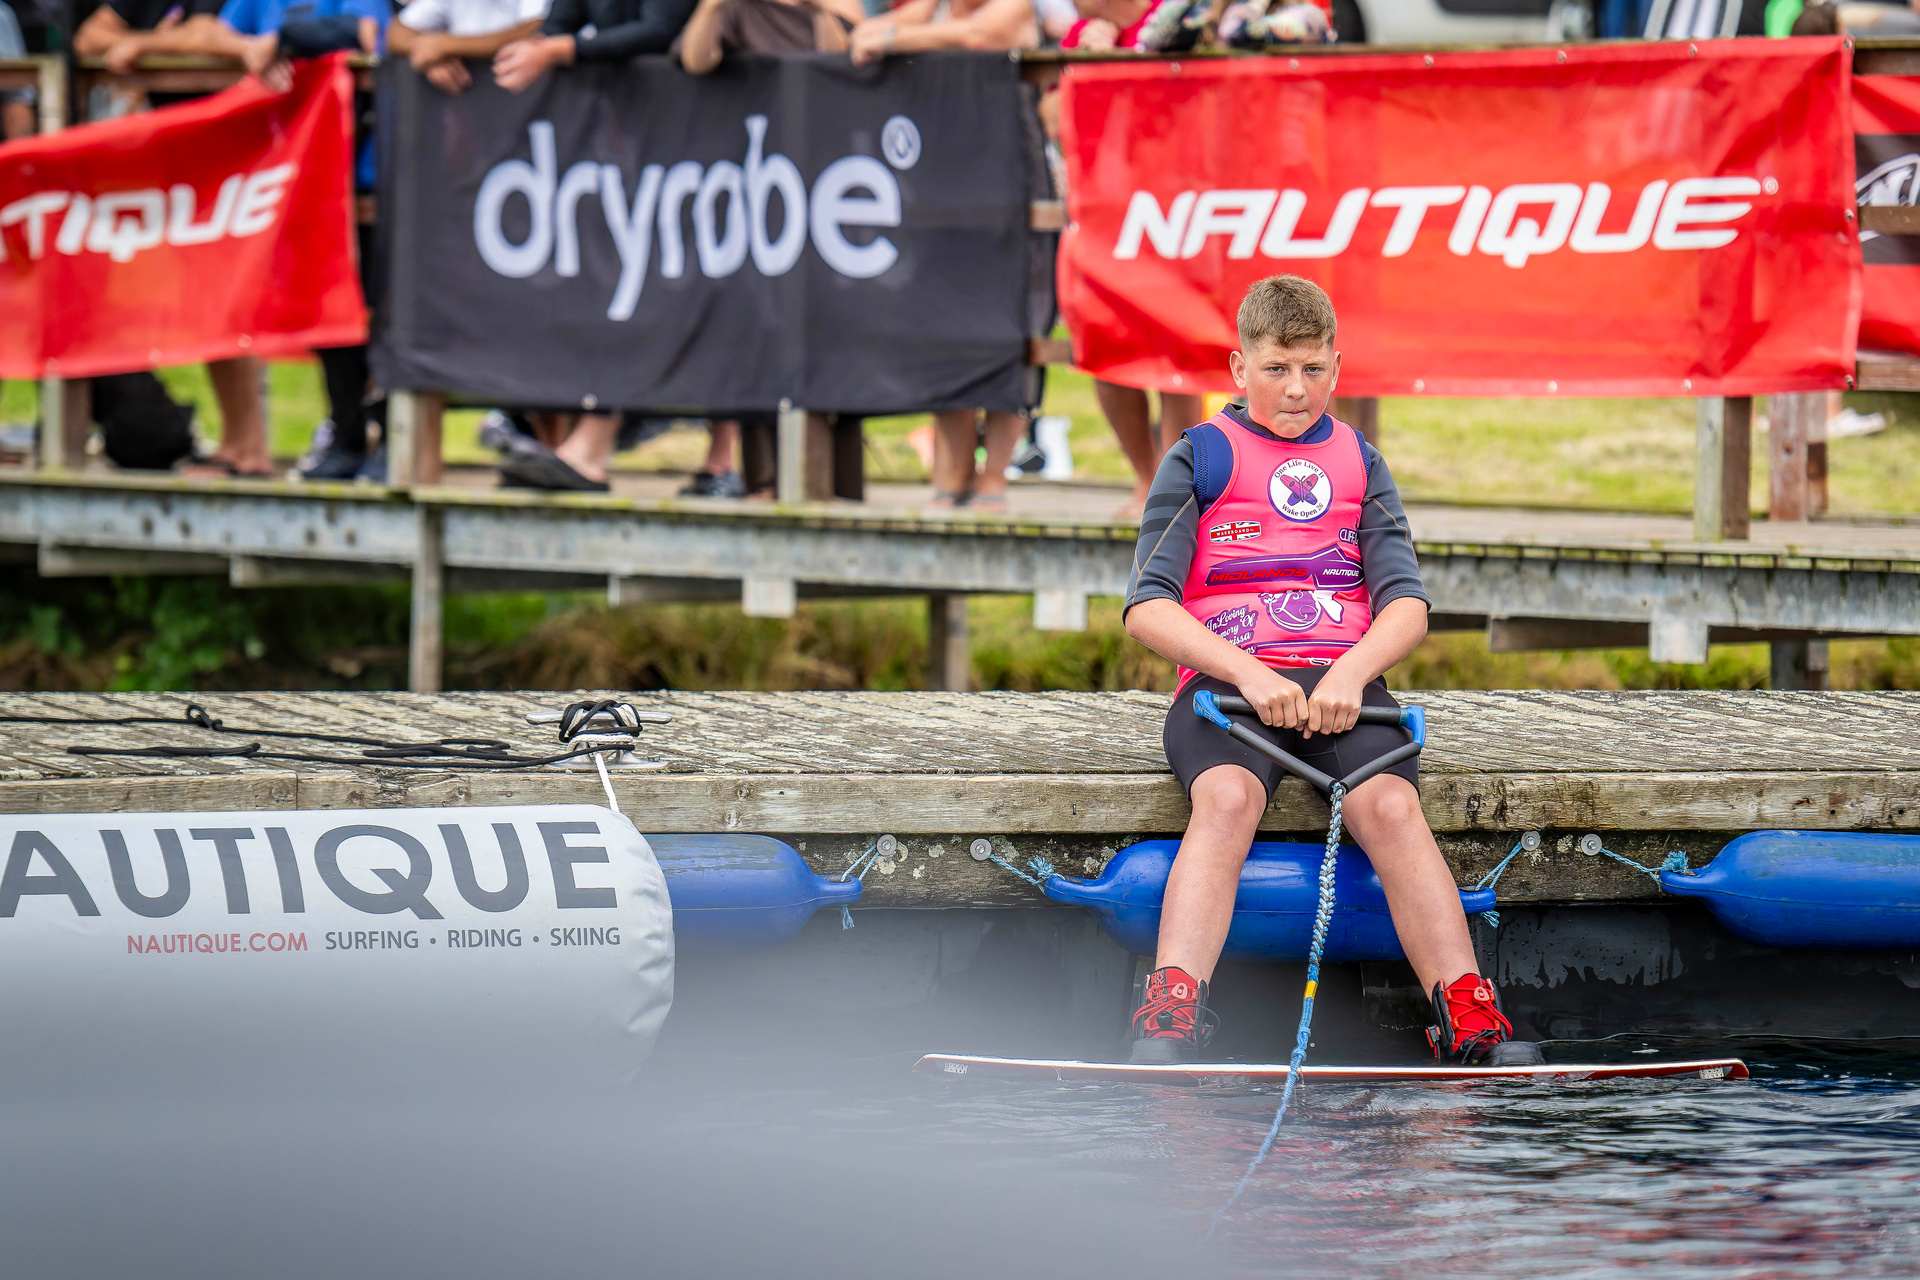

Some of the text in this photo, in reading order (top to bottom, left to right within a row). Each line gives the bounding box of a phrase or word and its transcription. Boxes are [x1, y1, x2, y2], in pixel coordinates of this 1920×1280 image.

[0, 162, 299, 263] TIQUE
[473, 114, 902, 322] dryrobe
[1112, 176, 1762, 268] NAUTIQUE
[1274, 465, 1287, 478] One
[1287, 460, 1302, 468] Life
[1304, 461, 1319, 473] Live
[1282, 504, 1299, 516] Wake
[1300, 508, 1318, 518] Open
[1209, 568, 1309, 582] MIDLANDS
[1322, 568, 1360, 577] NAUTIQUE
[1206, 607, 1246, 631] In Loving
[1240, 613, 1256, 627] Of
[127, 927, 621, 954] NAUTIQUE.COM SURFING RIDING SKIING
